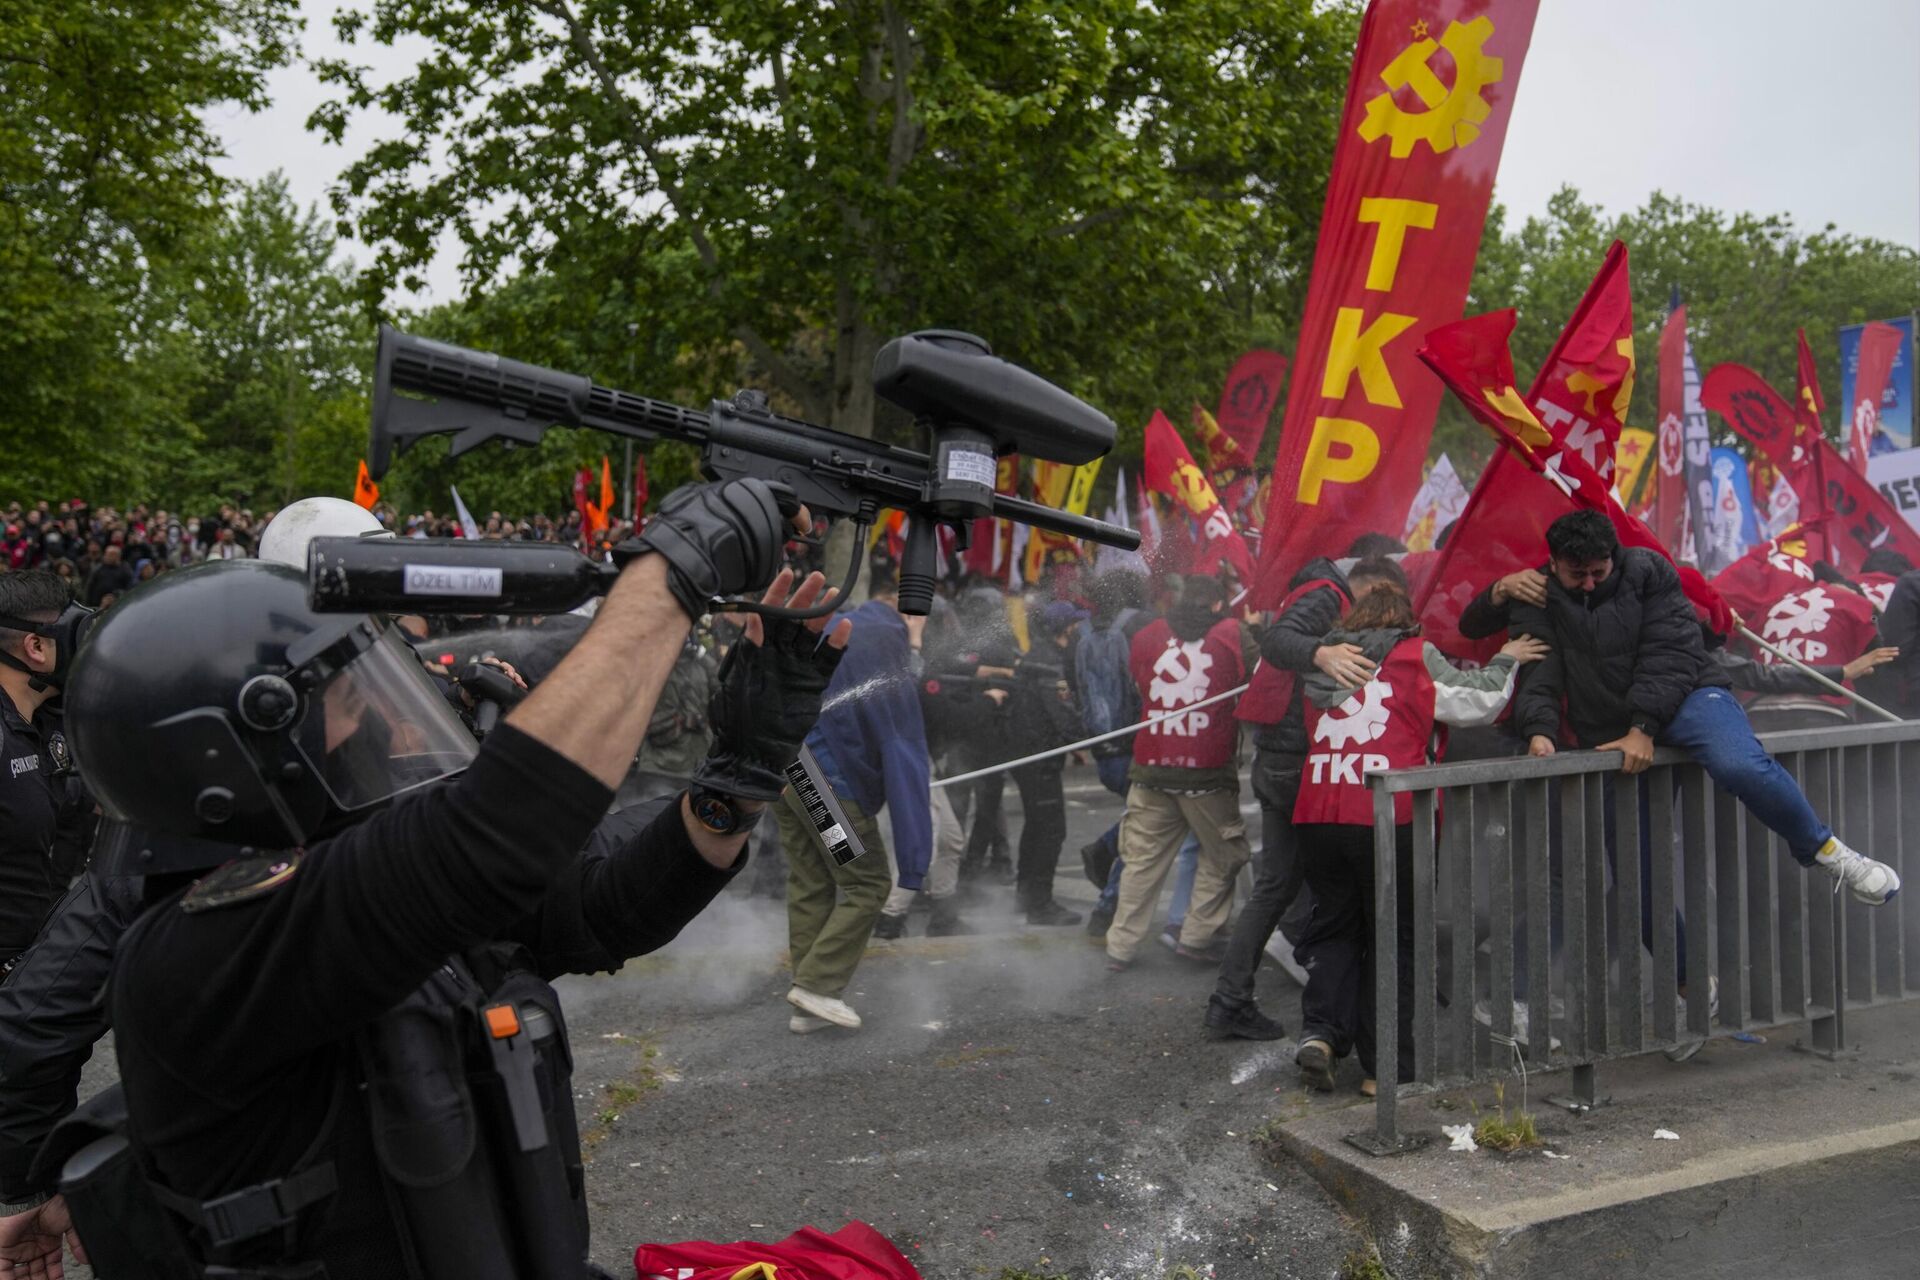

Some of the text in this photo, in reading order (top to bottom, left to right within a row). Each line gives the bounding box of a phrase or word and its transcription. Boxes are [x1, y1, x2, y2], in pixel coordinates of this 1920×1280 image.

[1296, 197, 1439, 506] TKP
[410, 570, 456, 590] ÖZEL
[1148, 710, 1210, 737] TKP
[1309, 752, 1390, 785] TKP
